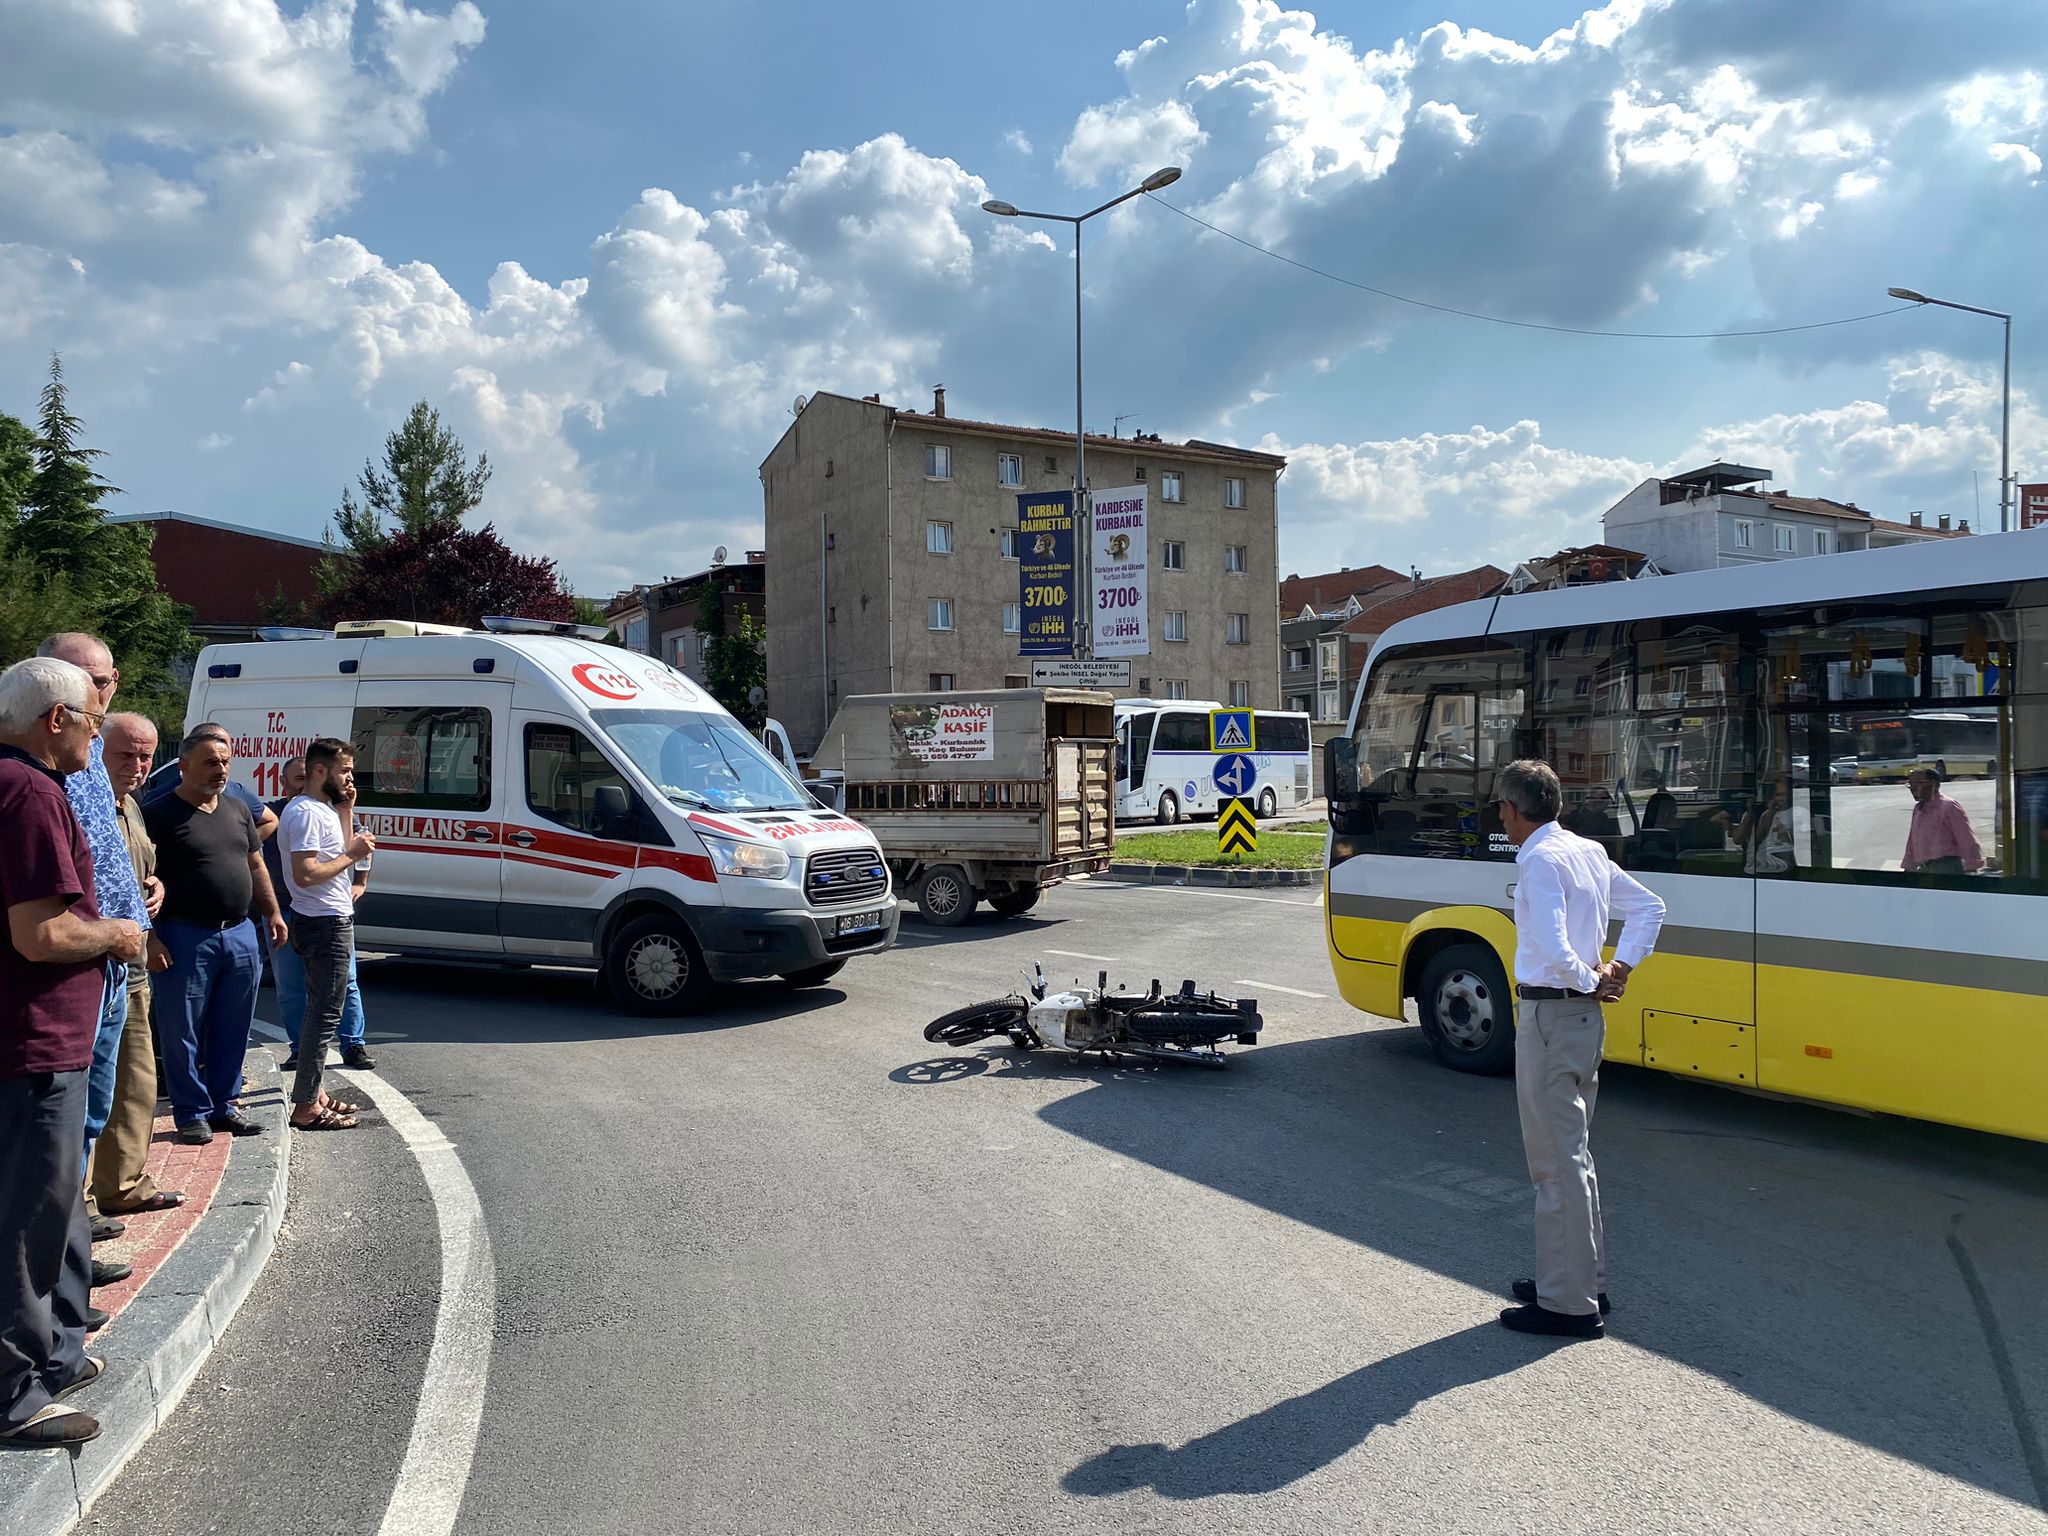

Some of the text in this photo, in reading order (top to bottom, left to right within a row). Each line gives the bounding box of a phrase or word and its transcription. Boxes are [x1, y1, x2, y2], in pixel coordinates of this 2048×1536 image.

[1027, 504, 1064, 518] KURBAN
[1096, 514, 1144, 531] KURBAN OL
[598, 673, 637, 688] 112
[941, 707, 991, 719] ADAKÇI
[268, 712, 287, 733] T.C.
[944, 719, 988, 735] KAŞİF
[253, 762, 288, 797] 11
[360, 814, 467, 841] MBULANS
[1489, 833, 1509, 842] OTOK
[1489, 844, 1520, 853] CENTRO
